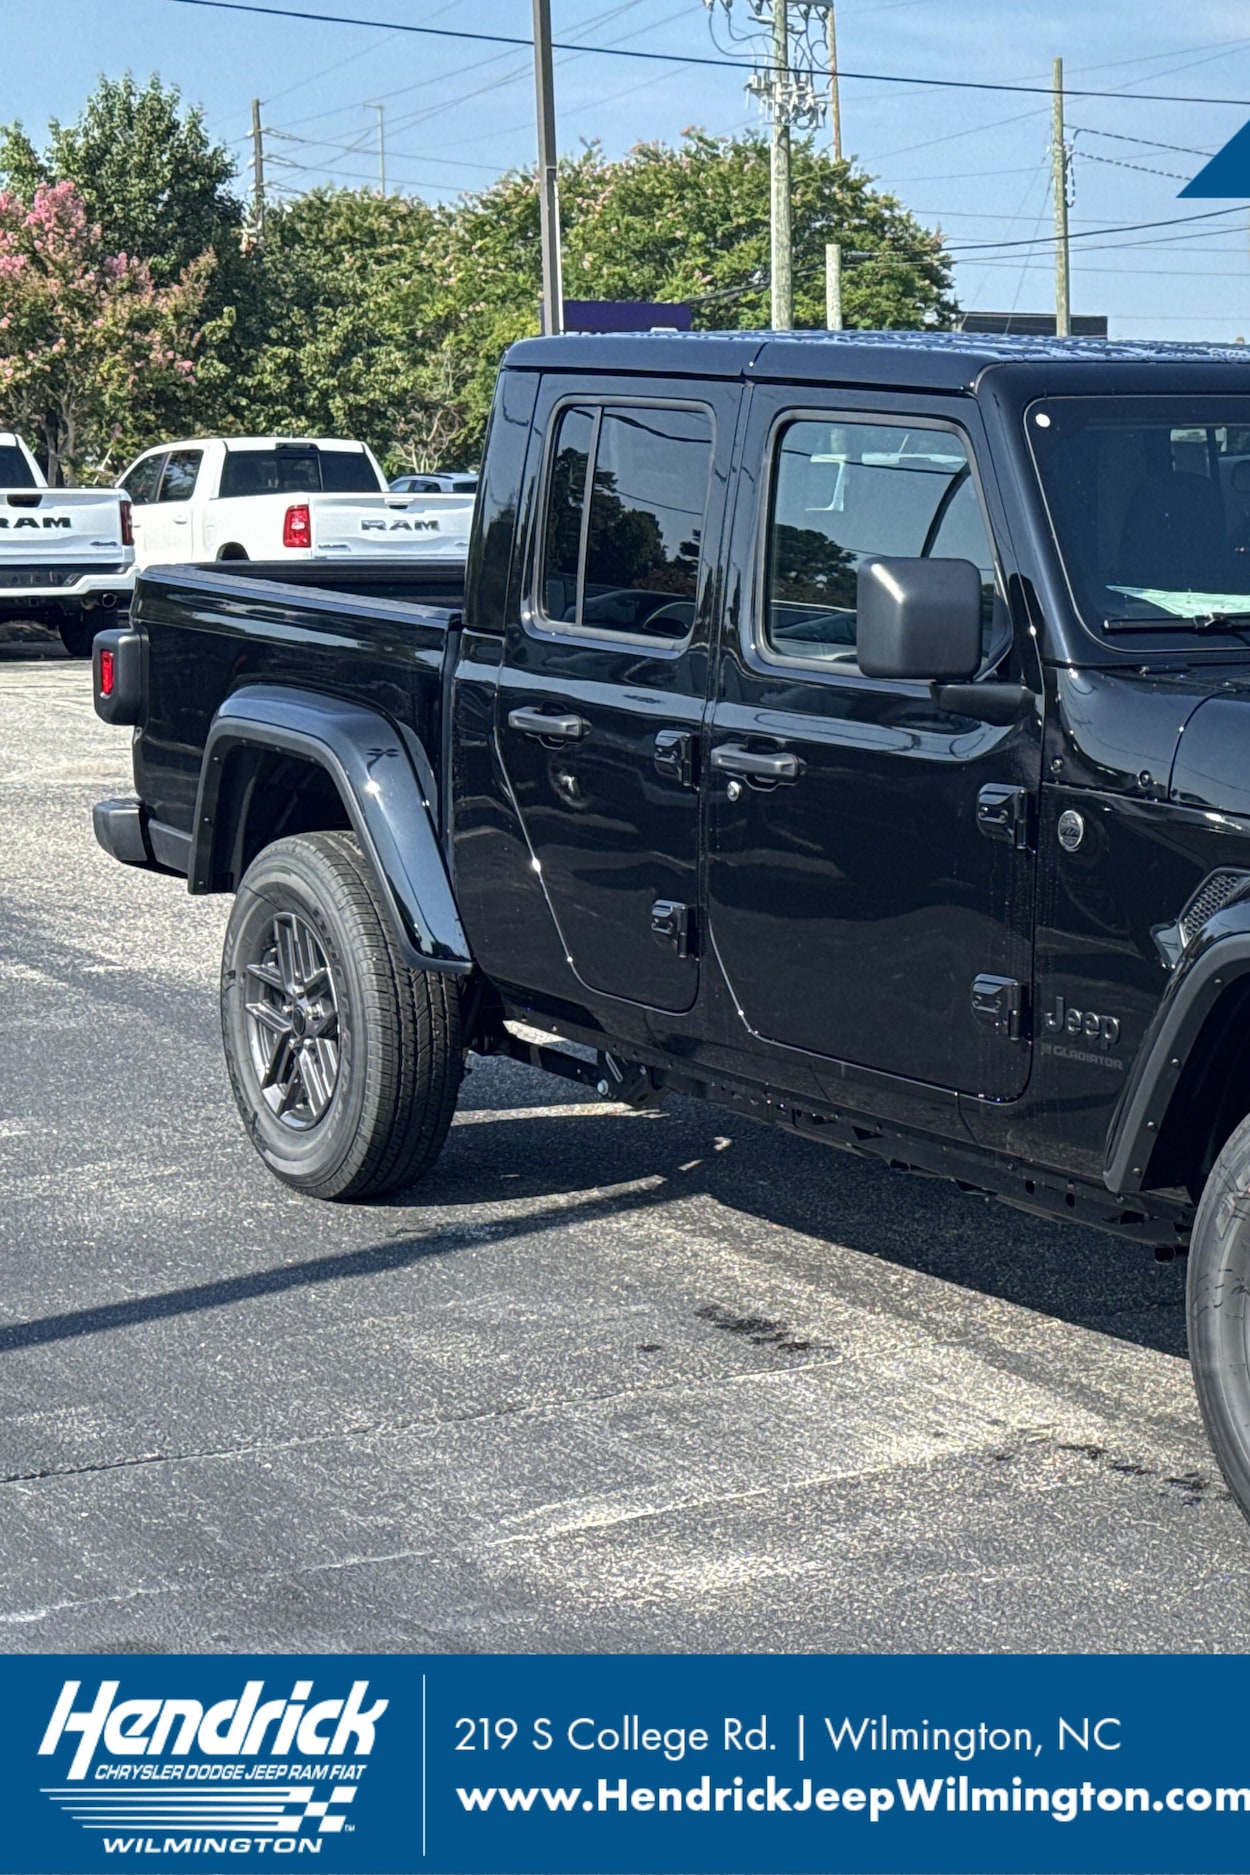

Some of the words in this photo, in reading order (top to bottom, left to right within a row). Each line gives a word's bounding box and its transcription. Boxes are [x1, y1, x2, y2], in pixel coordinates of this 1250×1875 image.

[361, 519, 440, 531] RAM
[1044, 996, 1121, 1050] Jeep
[1053, 1045, 1124, 1071] GLADIATOR
